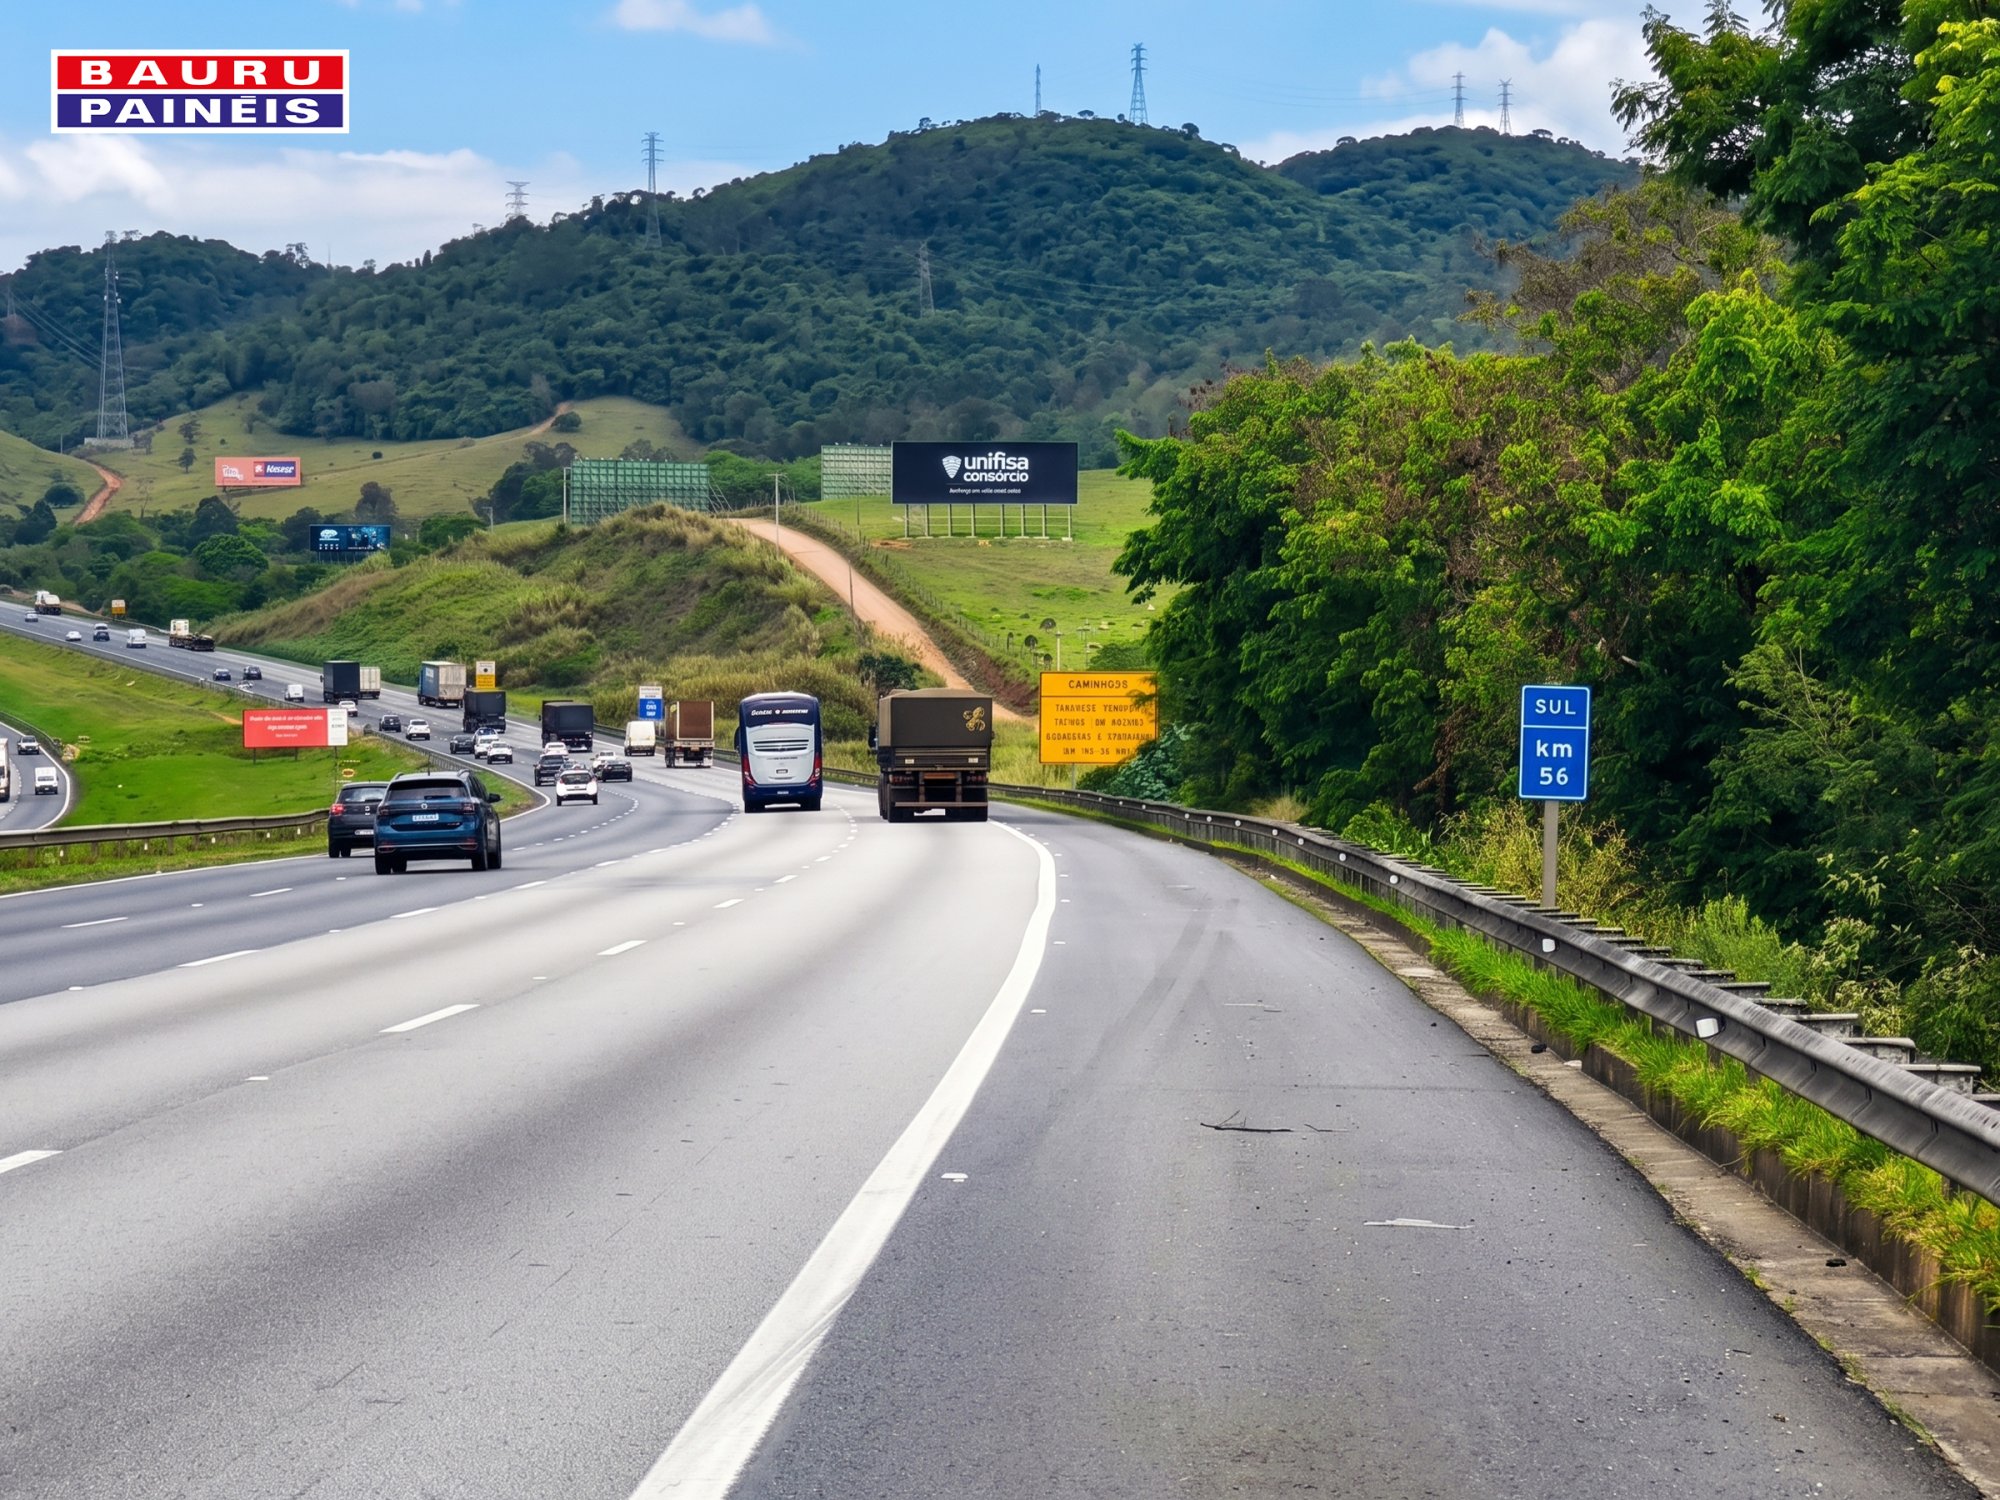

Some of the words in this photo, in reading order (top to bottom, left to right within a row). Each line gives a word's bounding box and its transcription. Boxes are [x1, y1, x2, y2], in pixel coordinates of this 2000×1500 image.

[964, 451, 1029, 470] unifisa
[963, 470, 1029, 483] consórcio
[1535, 699, 1576, 715] SUL
[1536, 739, 1573, 758] km
[1539, 767, 1569, 785] 56
